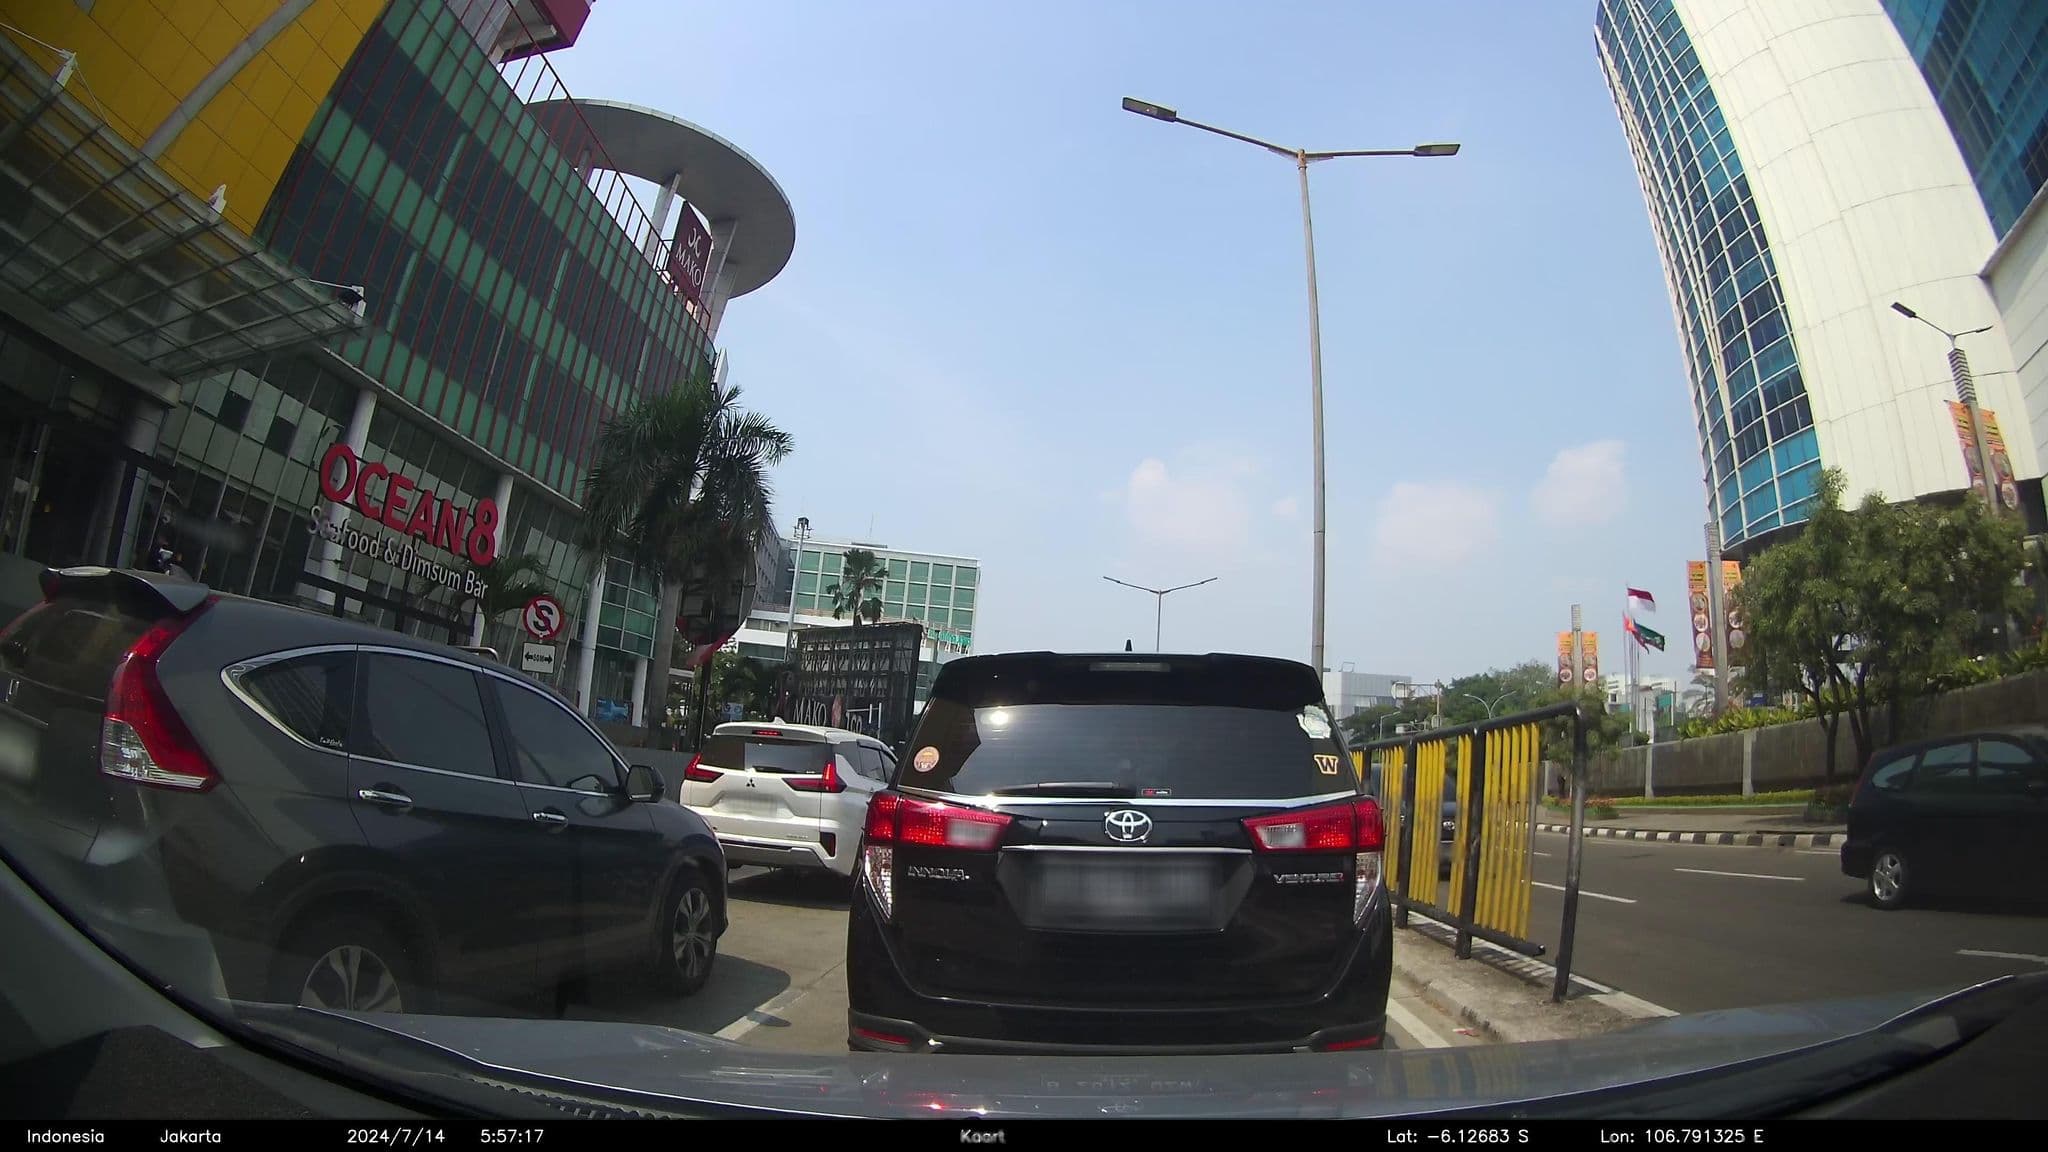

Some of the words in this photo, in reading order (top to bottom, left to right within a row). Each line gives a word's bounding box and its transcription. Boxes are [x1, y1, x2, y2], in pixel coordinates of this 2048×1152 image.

[676, 243, 702, 287] MAKO
[307, 505, 382, 559] Seafood
[384, 539, 401, 565] &
[402, 544, 462, 591] Dimsum
[465, 569, 489, 599] Bar
[793, 697, 827, 726] MAKO
[1315, 756, 1338, 774] W
